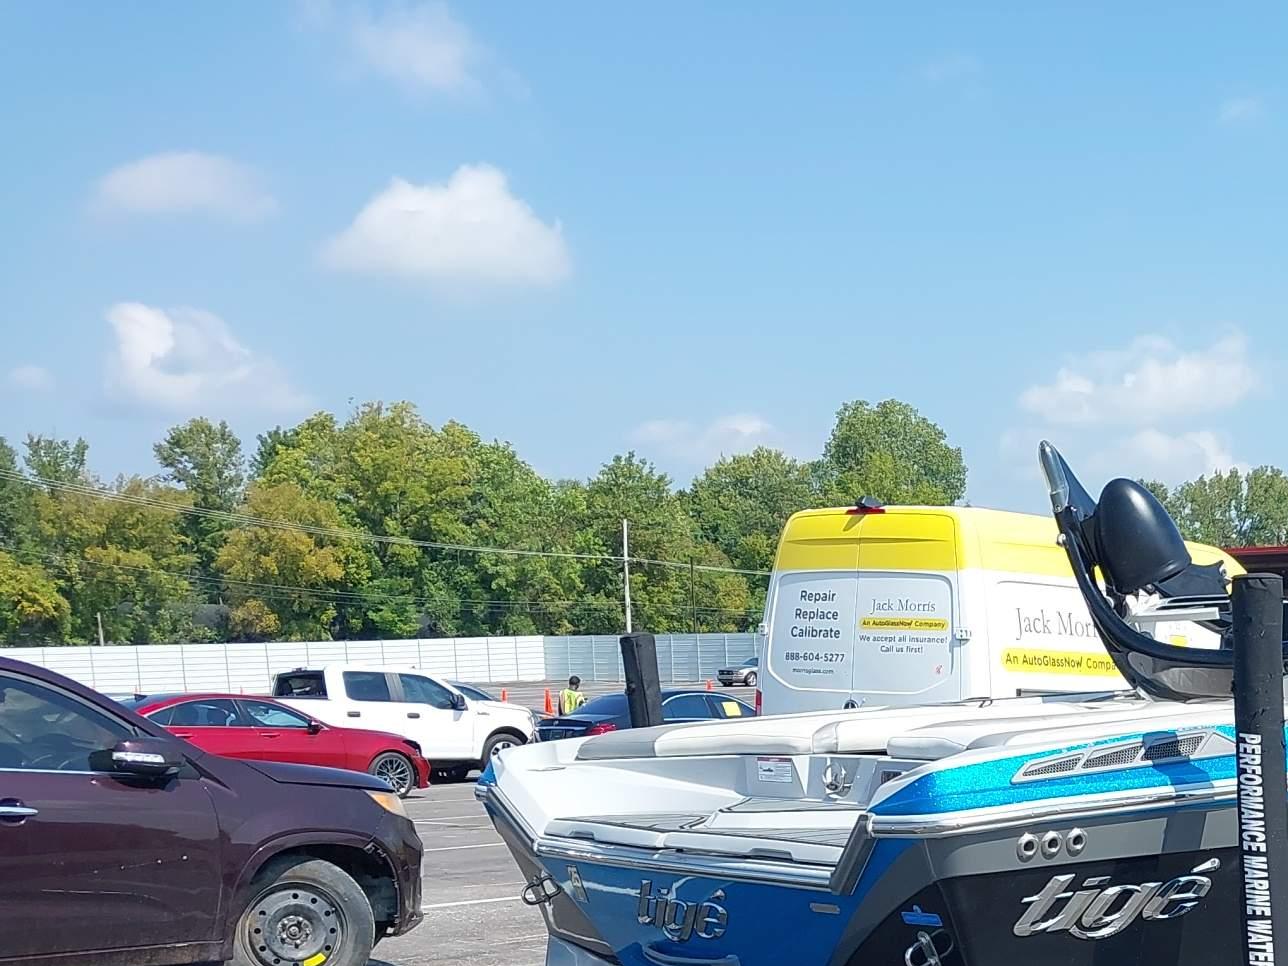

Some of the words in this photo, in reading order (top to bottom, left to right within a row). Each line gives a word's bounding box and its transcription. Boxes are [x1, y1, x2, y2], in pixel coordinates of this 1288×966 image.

[800, 590, 836, 604] Repair
[870, 599, 894, 615] Jack
[897, 599, 936, 612] Morris
[795, 608, 839, 622] Replace
[914, 620, 946, 629] Company
[1015, 607, 1052, 641] Jack
[791, 626, 841, 639] Calibrate
[872, 635, 896, 643] accept
[898, 634, 907, 643] all
[908, 634, 948, 644] insurance!
[880, 645, 894, 653] Call
[906, 645, 924, 654] first!
[785, 652, 845, 662] 888-604-5277
[1005, 653, 1019, 665] An
[1238, 732, 1268, 853] PERFORMANCE
[1243, 854, 1273, 917] MARINE
[1013, 857, 1221, 940] tigé
[637, 879, 729, 943] tigé
